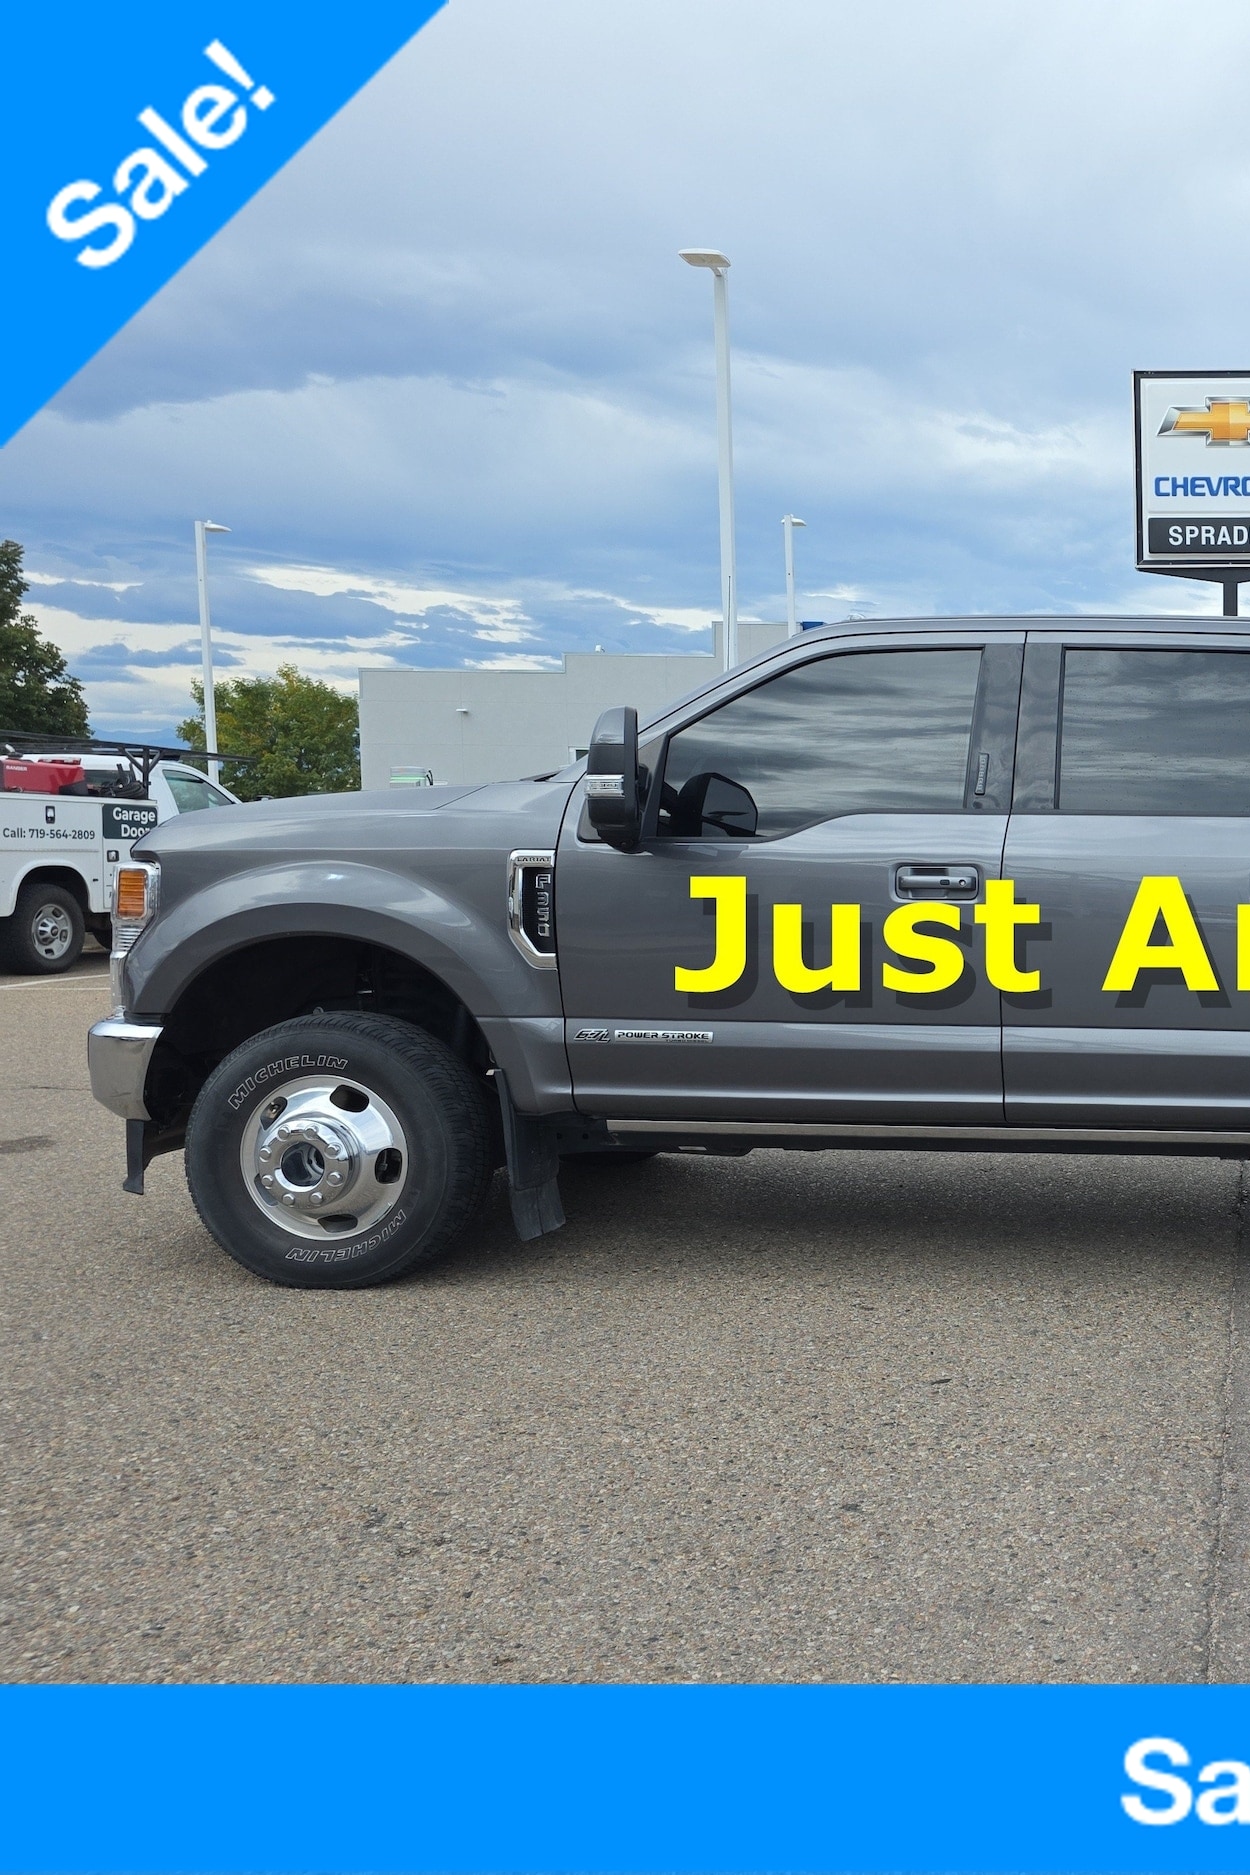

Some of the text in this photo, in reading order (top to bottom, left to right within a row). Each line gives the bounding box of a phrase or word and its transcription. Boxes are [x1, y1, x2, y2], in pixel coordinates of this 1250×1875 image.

[112, 806, 156, 825] Garage
[2, 827, 96, 840] Call: 719-564-2809
[617, 1031, 659, 1039] POWER
[661, 1032, 710, 1040] STROKE
[227, 1054, 349, 1110] MICHELIN
[285, 1209, 408, 1263] MICHELIN
